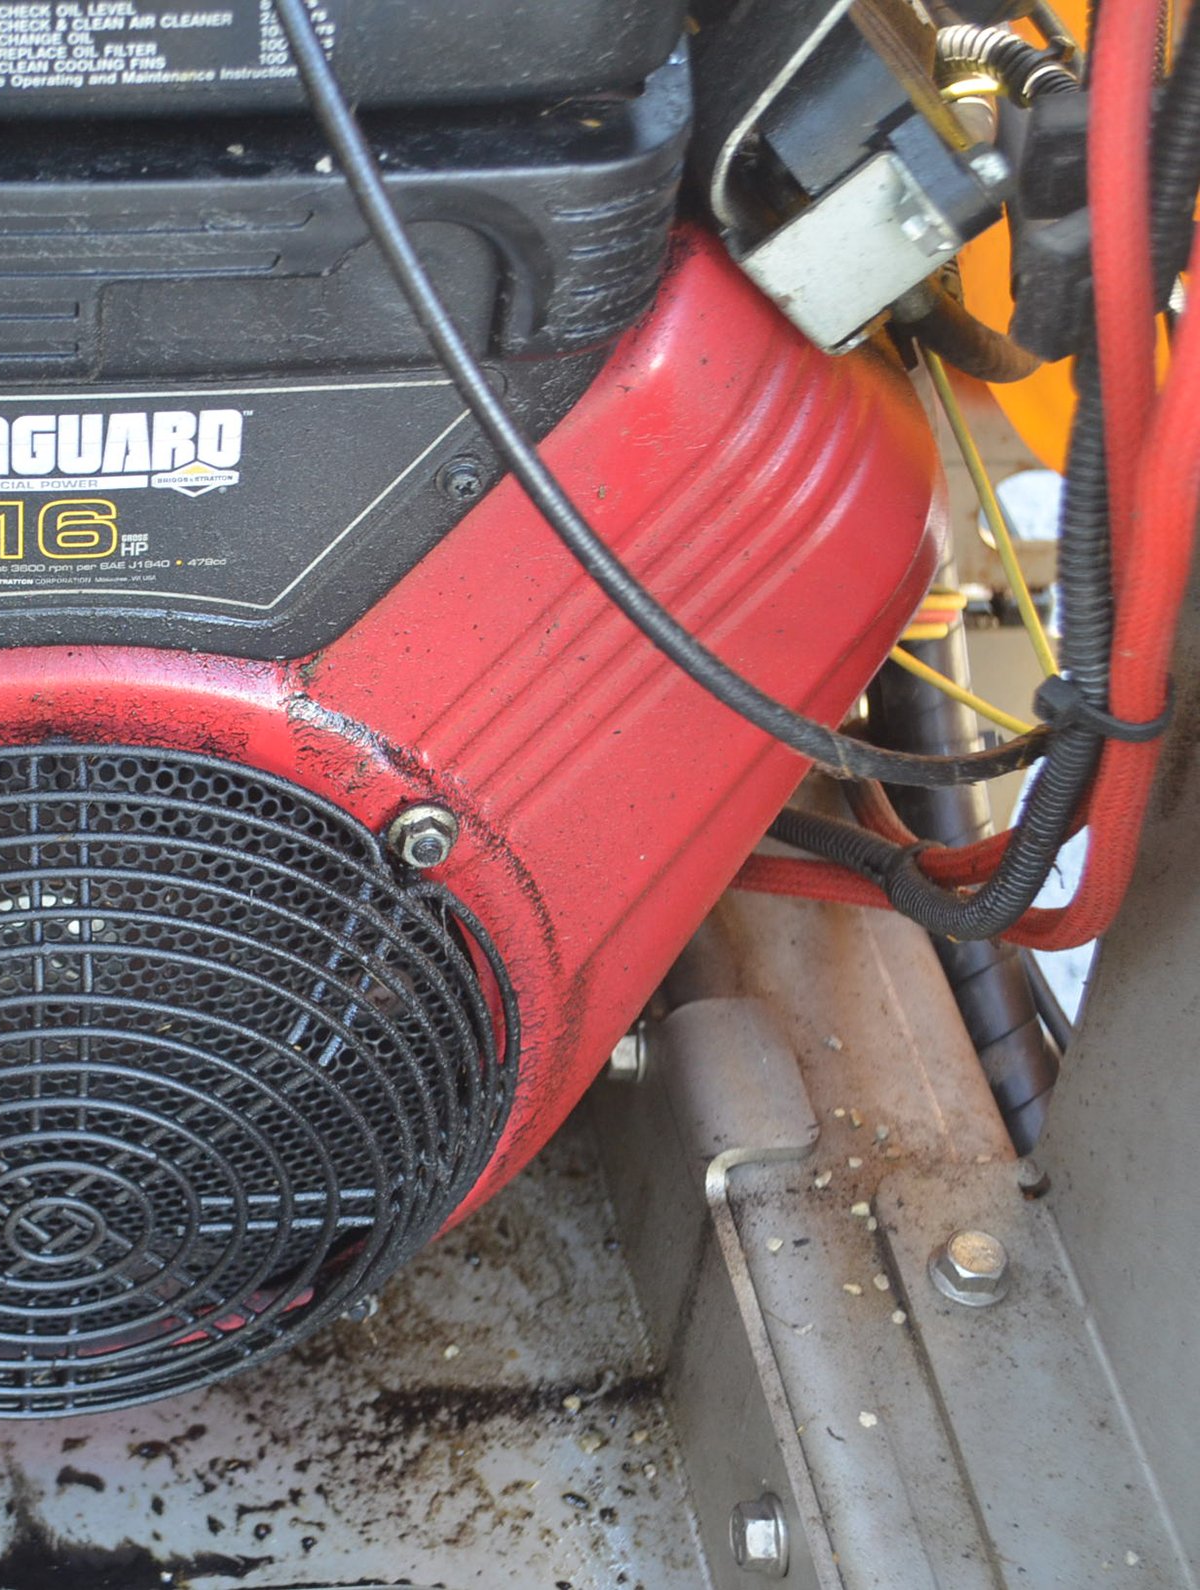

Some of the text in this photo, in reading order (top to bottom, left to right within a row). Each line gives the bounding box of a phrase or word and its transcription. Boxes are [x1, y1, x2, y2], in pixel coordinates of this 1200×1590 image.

[56, 3, 83, 18] OIL
[88, 2, 137, 17] LEVEL
[56, 18, 68, 31] &
[71, 15, 125, 31] CLEAN
[129, 14, 156, 30] AIR
[160, 11, 233, 29] CLEANER
[67, 31, 95, 45] OIL
[72, 45, 99, 59] OIL
[103, 42, 158, 58] FILTER
[54, 57, 125, 73] COOLING
[130, 55, 167, 70] FINS
[259, 51, 289, 65] 100
[11, 72, 83, 90] Operating
[88, 71, 117, 86] and
[121, 69, 216, 84] Maintenance
[40, 479, 98, 489] POWER
[121, 541, 149, 556] HP
[10, 564, 46, 573] 3600
[48, 563, 73, 574] rpm
[76, 562, 98, 572] per
[99, 561, 126, 571] SAE
[34, 576, 92, 584] CORPORATION
